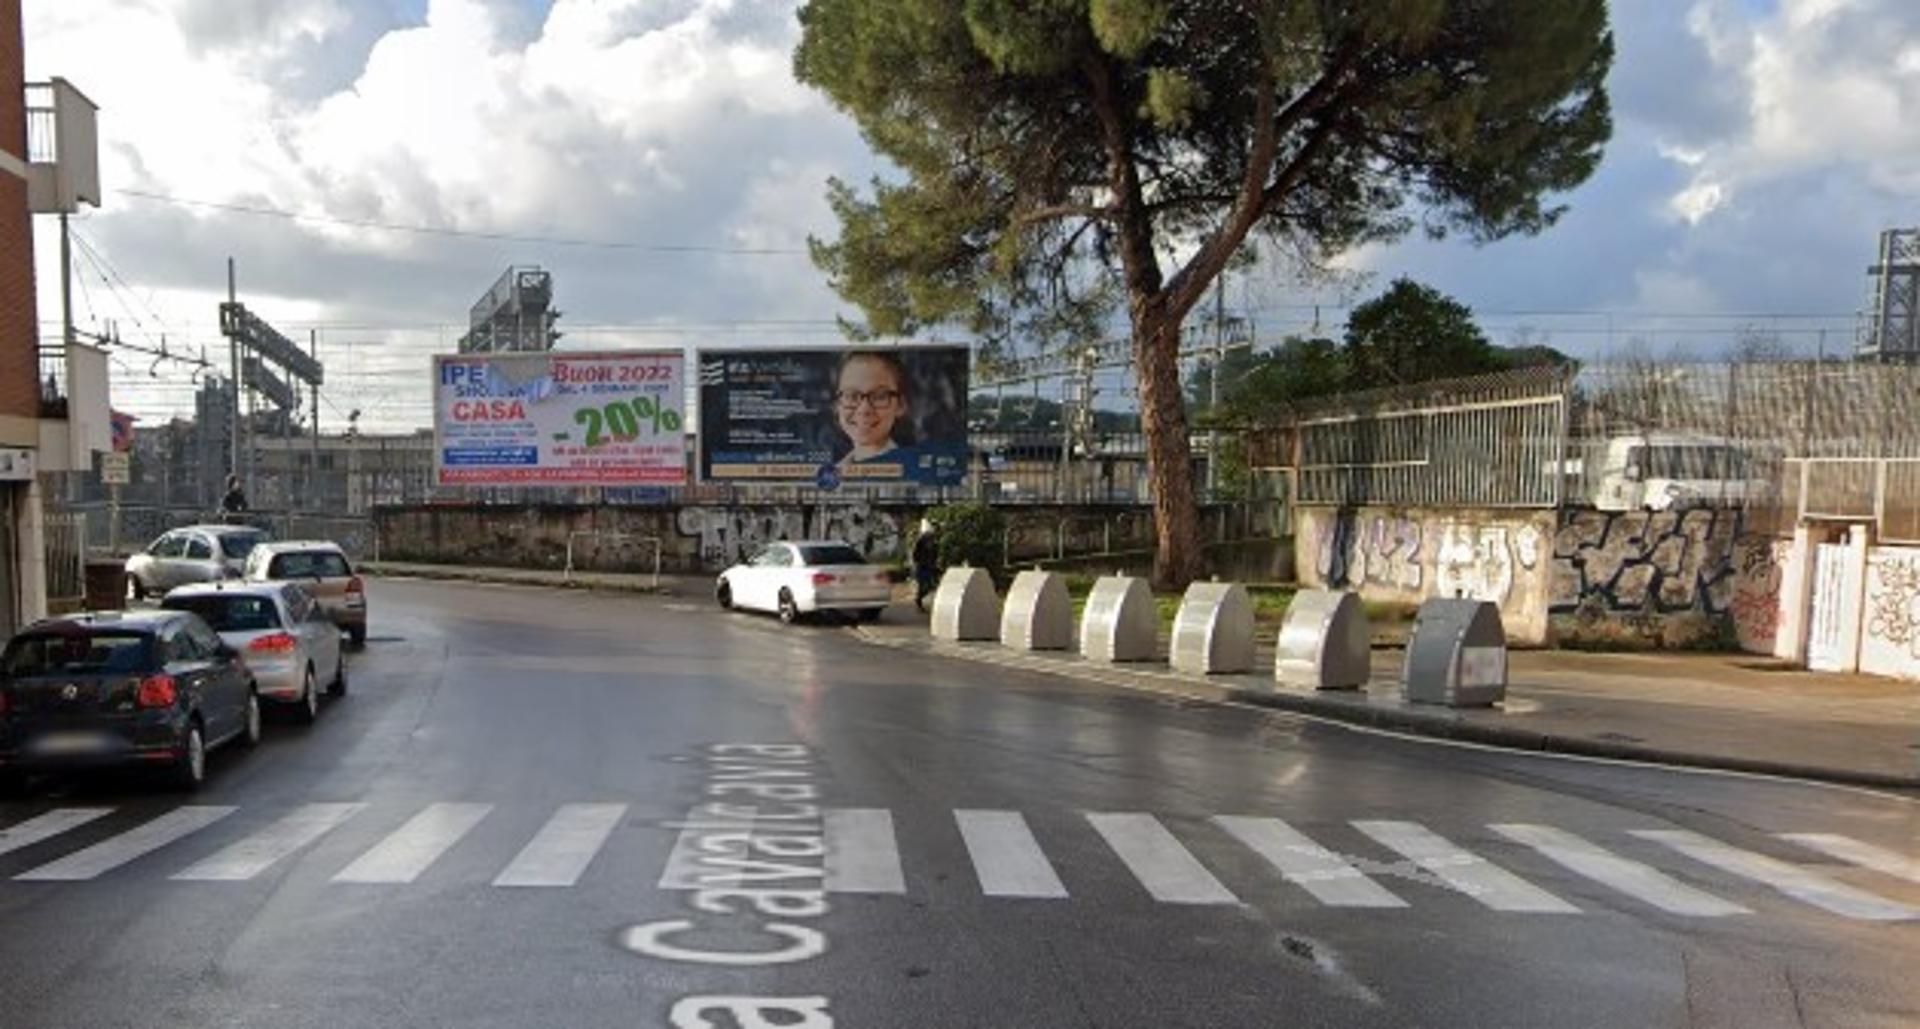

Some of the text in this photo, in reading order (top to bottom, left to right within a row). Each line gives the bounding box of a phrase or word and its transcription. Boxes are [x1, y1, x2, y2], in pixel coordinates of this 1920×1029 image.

[441, 364, 485, 385] IPE
[618, 365, 673, 382] 2022
[453, 400, 526, 421] CASA
